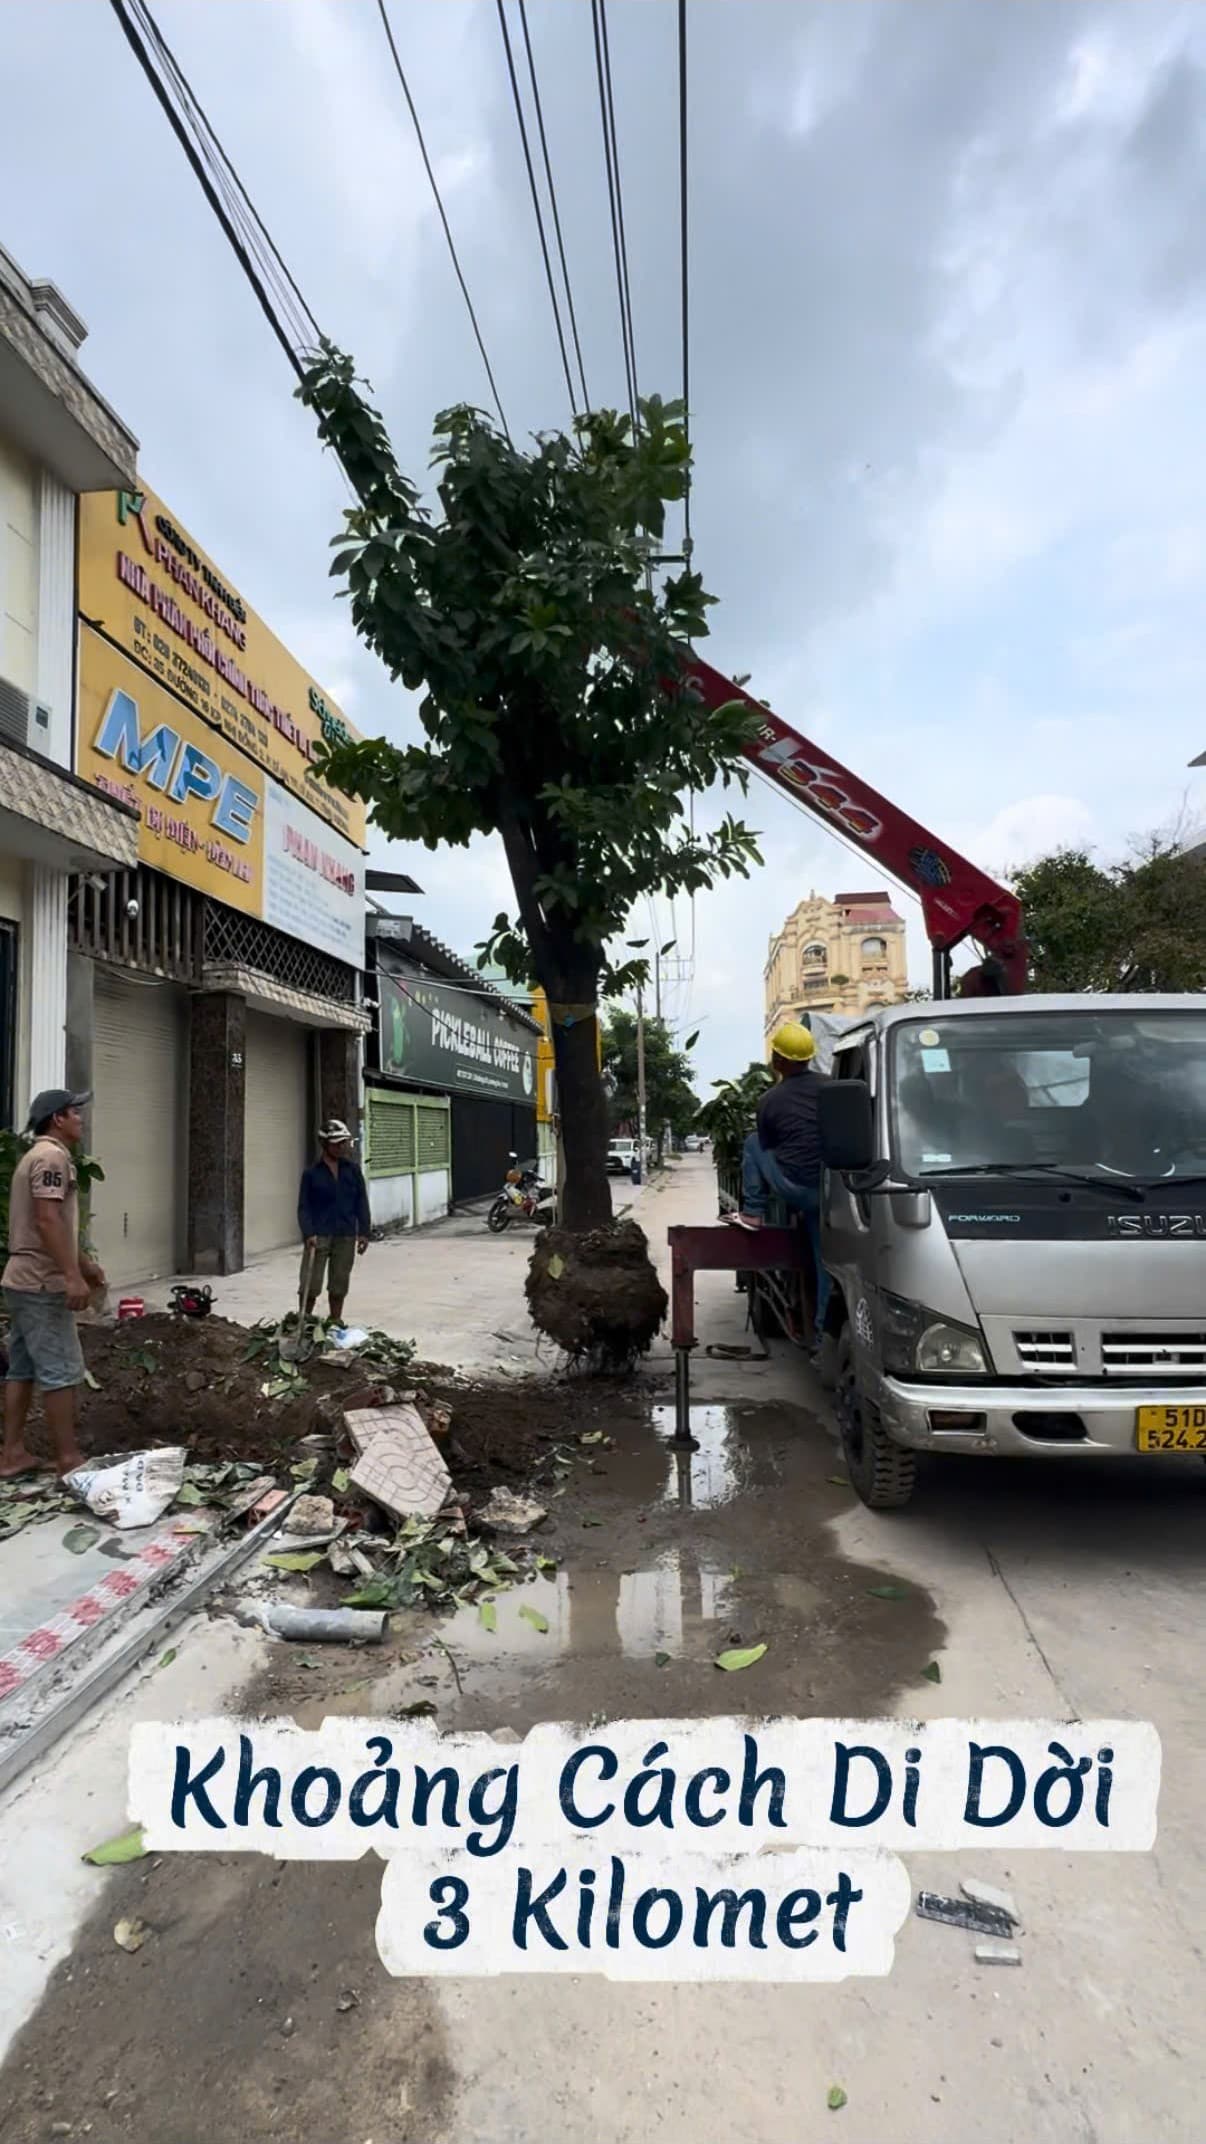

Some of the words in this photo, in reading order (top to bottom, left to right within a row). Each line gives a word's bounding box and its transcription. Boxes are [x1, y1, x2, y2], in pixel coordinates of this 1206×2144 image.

[154, 538, 200, 602] PHAN
[199, 586, 246, 652] KHANG
[93, 687, 260, 844] MPE
[431, 1008, 492, 1064] PICKLEBALL
[493, 1036, 520, 1074] COFFEE
[42, 1170, 62, 1188] 85
[948, 1213, 1021, 1223] FORWARD
[1165, 1408, 1206, 1428] 51D
